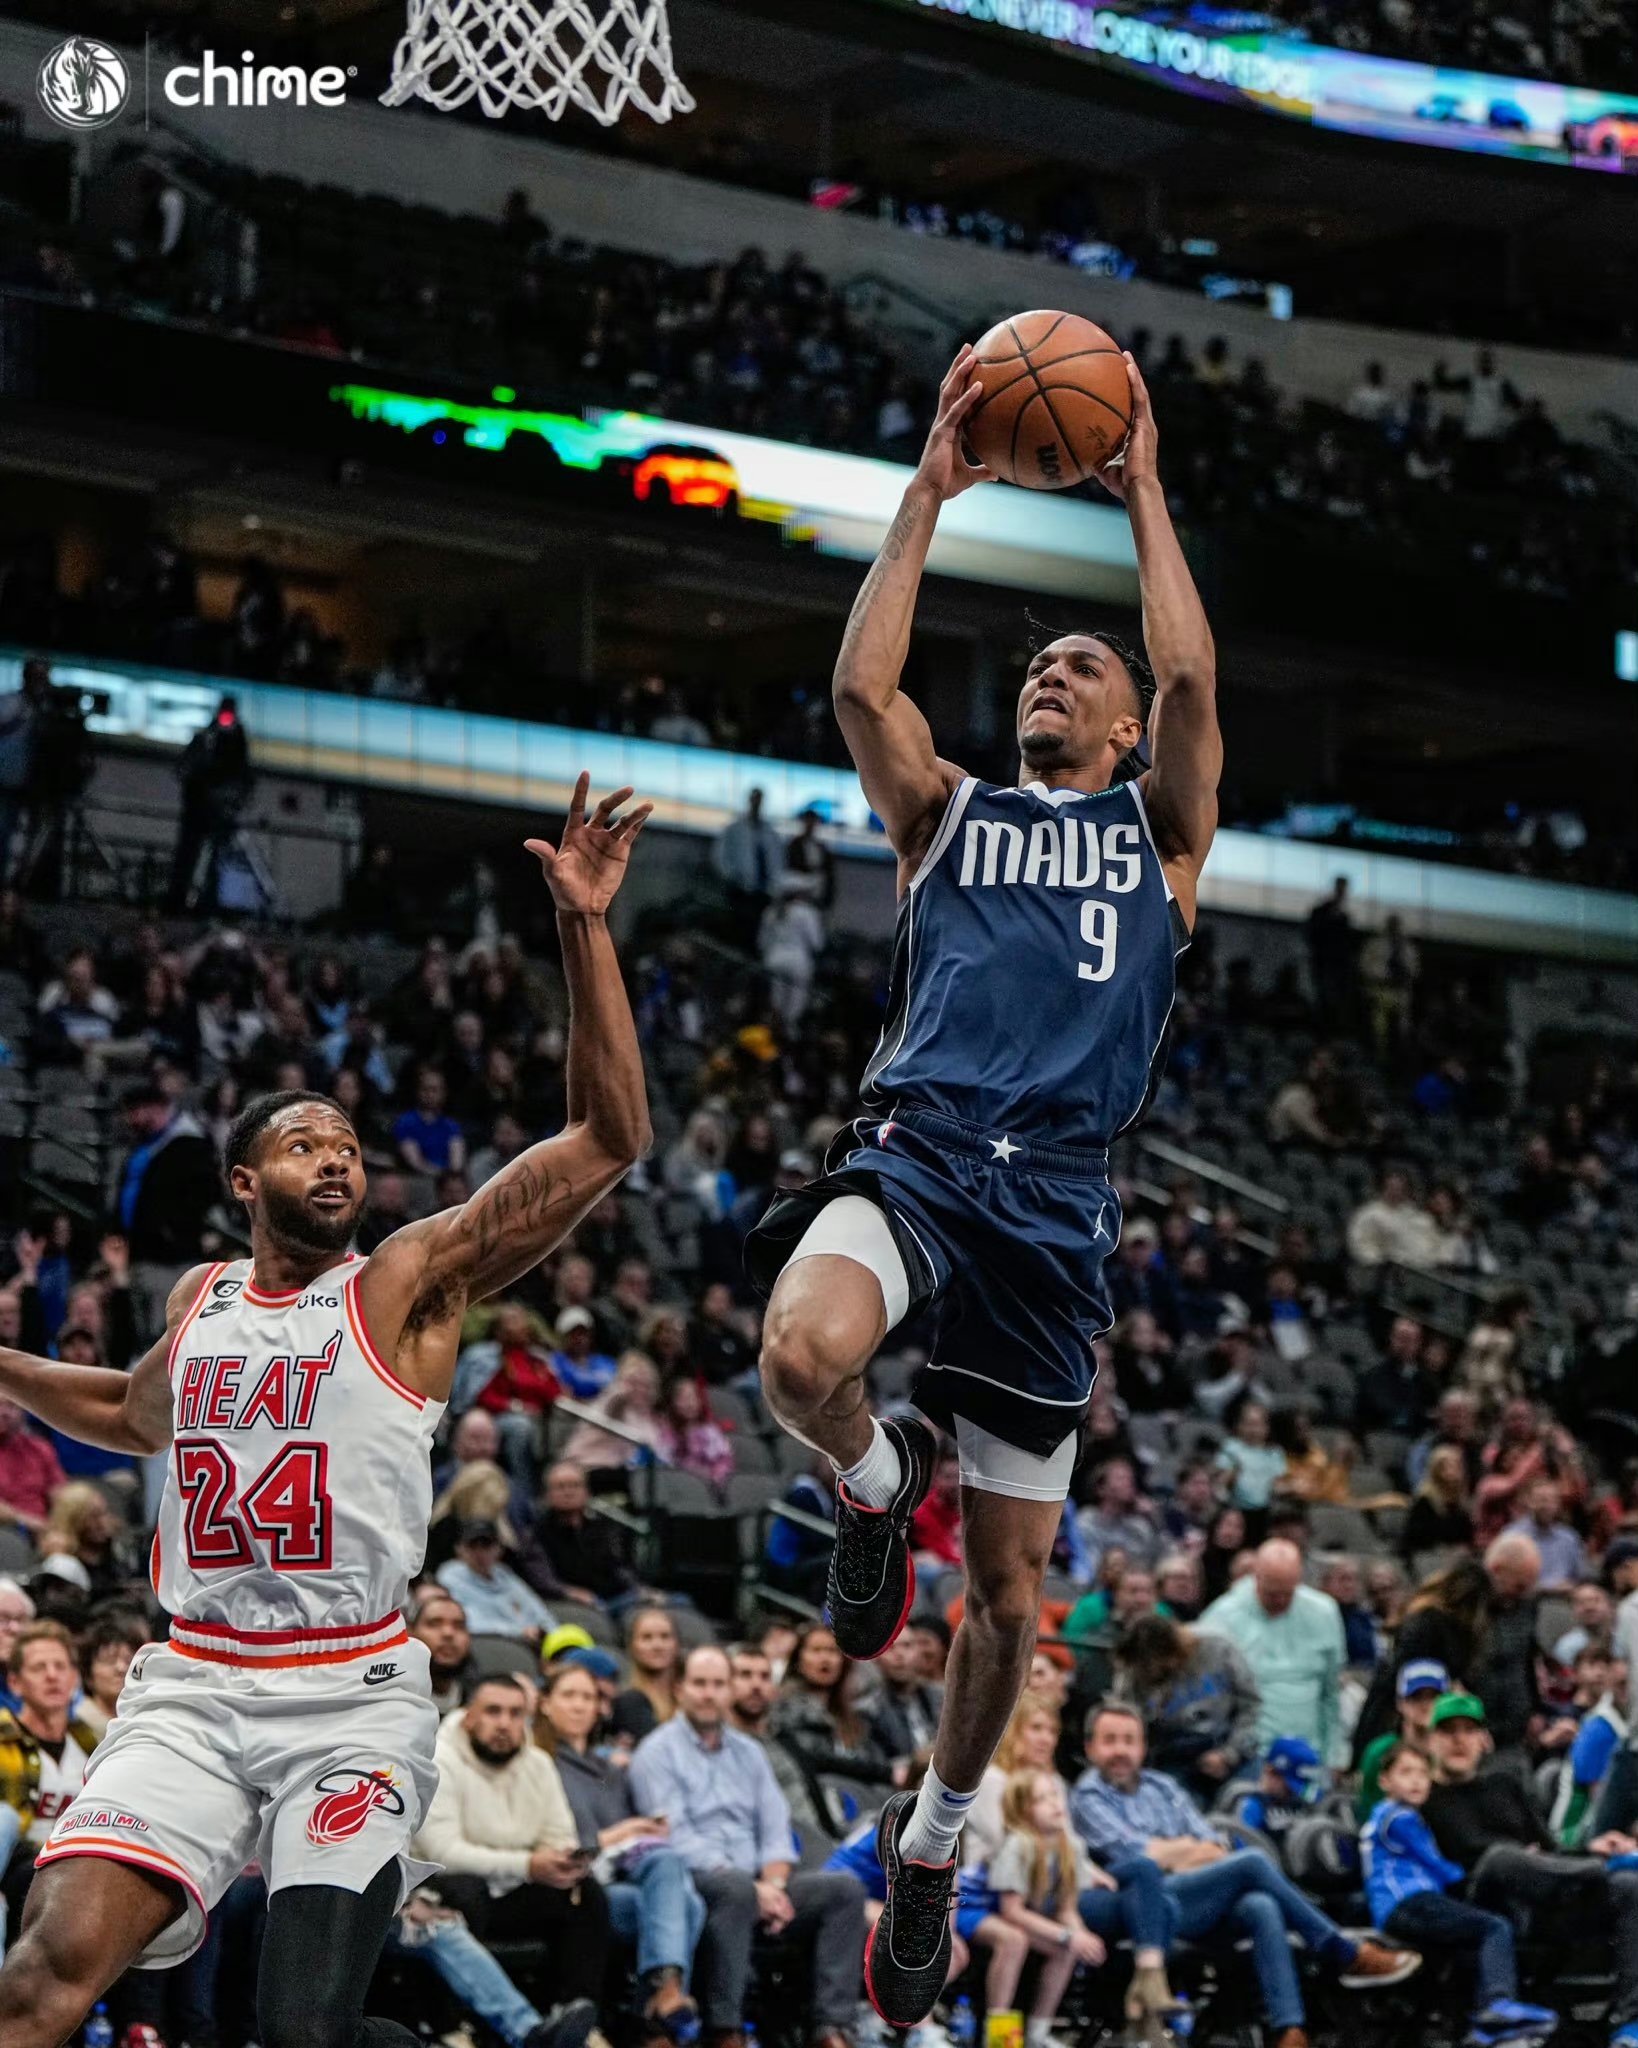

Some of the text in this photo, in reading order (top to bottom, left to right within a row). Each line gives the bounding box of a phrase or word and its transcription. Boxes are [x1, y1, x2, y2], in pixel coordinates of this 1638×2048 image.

[959, 817, 1142, 894] MAVS
[1077, 899, 1118, 982] 9
[298, 1294, 338, 1310] UKG
[177, 1329, 343, 1431] HEAT
[174, 1438, 332, 1571] 24
[369, 1663, 398, 1677] NIKE
[59, 1810, 149, 1834] MIAMI
